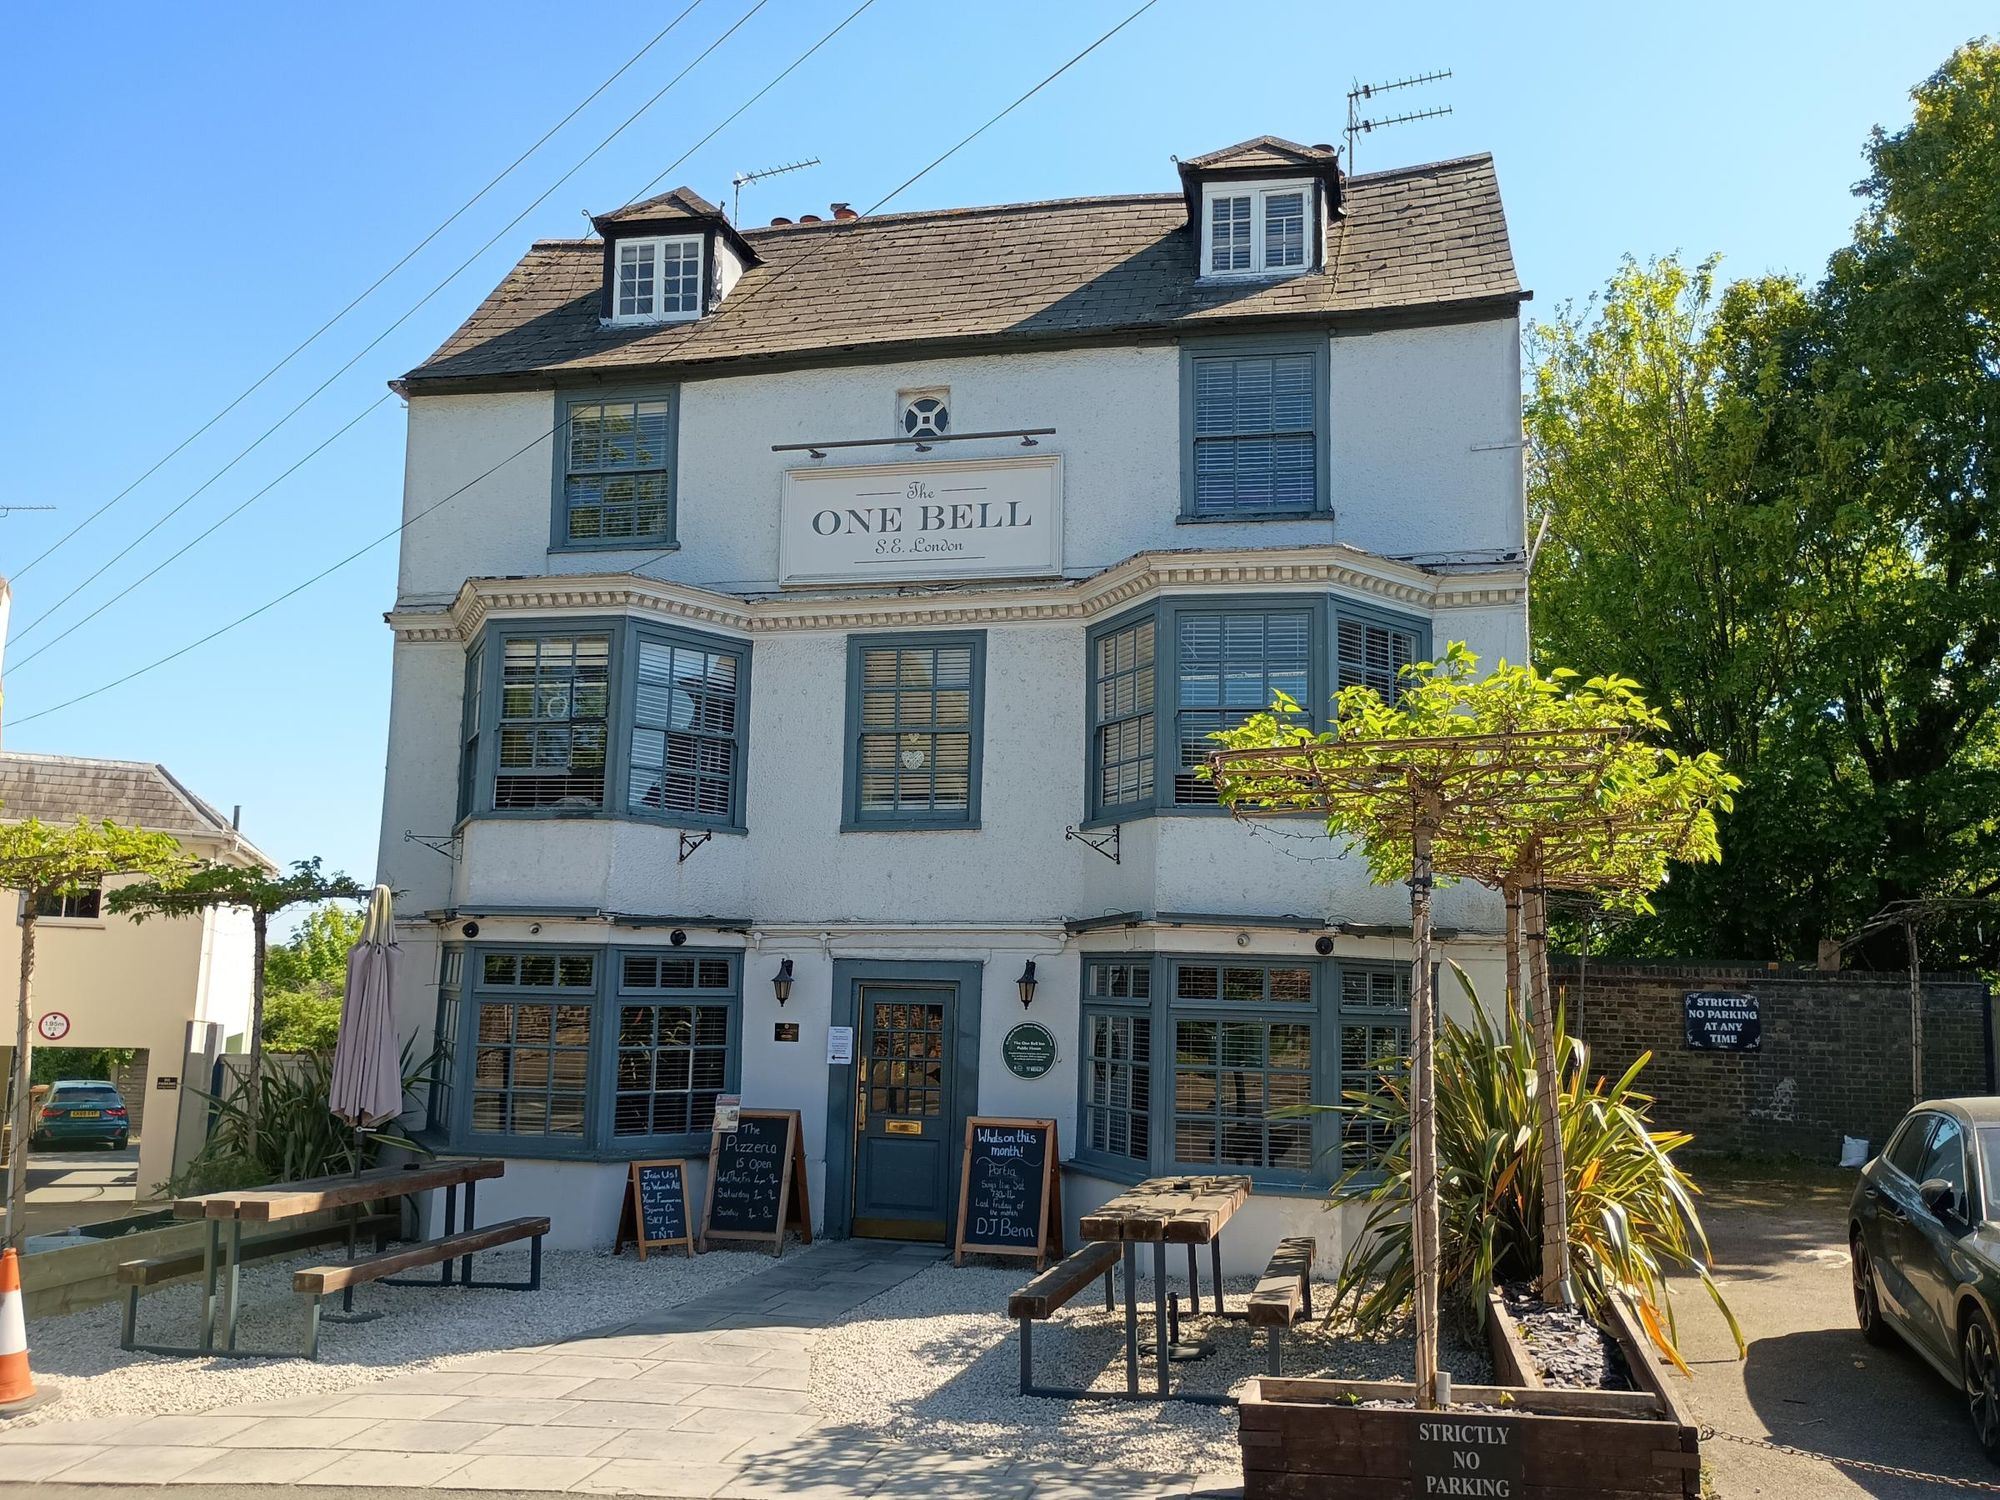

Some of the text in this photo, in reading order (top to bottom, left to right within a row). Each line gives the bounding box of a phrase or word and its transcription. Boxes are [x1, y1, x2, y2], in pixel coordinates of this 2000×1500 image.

[906, 481, 936, 500] The
[812, 501, 1032, 536] ONE BELL
[875, 537, 964, 555] S.E. London
[1696, 997, 1748, 1007] STRICTLY
[1688, 1009, 1758, 1020] NO PARKING
[1704, 1022, 1743, 1032] AT ANY
[1709, 1034, 1738, 1044] TIME
[741, 1122, 760, 1135] The
[725, 1134, 777, 1153] Pizzeria
[1003, 1135, 1016, 1143] on
[1016, 1129, 1037, 1144] this
[990, 1145, 1024, 1158] month!
[749, 1158, 772, 1172] Open
[643, 1168, 678, 1180] Join Us!
[641, 1182, 650, 1190] To
[718, 1187, 750, 1203] Saturday
[976, 1216, 1035, 1238] DJ Benn
[650, 1230, 675, 1240] TNT
[1419, 1422, 1510, 1445] STRICTLY
[1452, 1450, 1480, 1470] NO
[1425, 1475, 1510, 1498] PARKING
